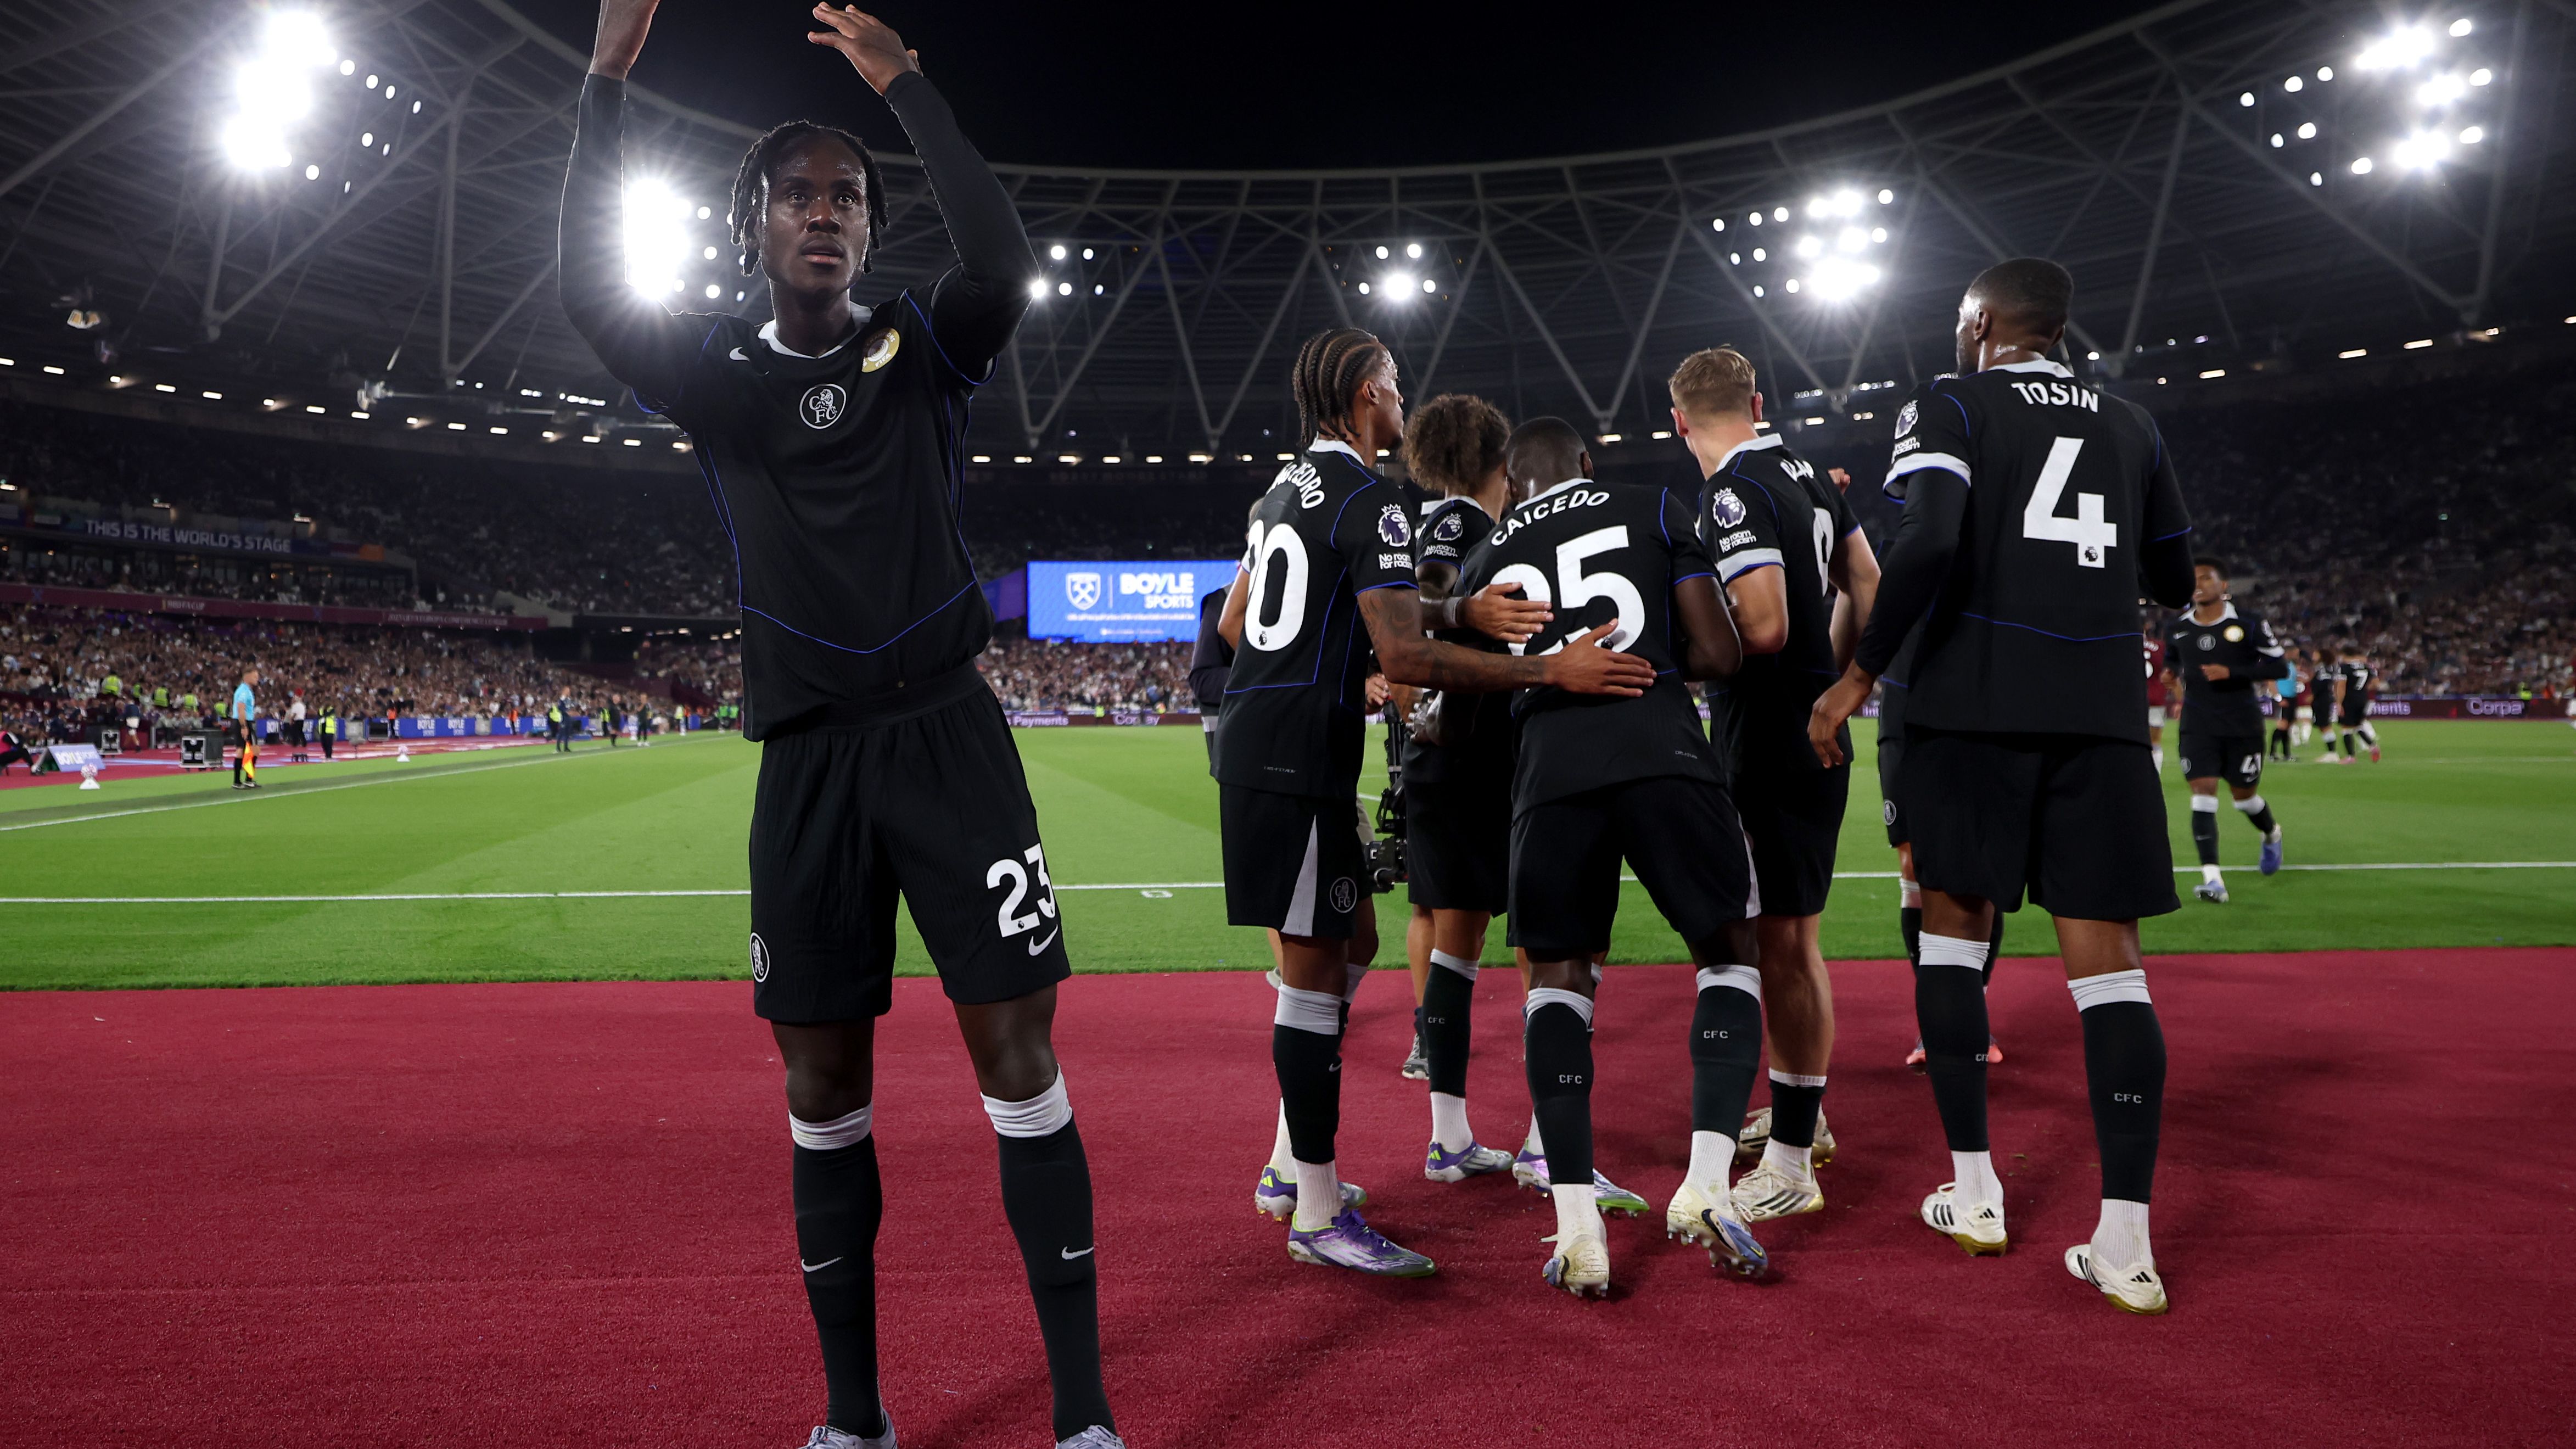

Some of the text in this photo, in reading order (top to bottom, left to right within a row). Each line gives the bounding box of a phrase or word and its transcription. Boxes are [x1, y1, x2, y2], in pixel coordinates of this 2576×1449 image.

[2011, 382, 2099, 413] TOSIN
[2023, 437, 2117, 568] 4
[1491, 489, 1610, 546] CAICEDO
[85, 519, 292, 553] THIS IS THE WORLD'S STAGE
[1719, 529, 1751, 546] No room
[1721, 535, 1757, 553] for racism
[1435, 545, 1456, 553] room
[1379, 553, 1412, 563] No room
[1380, 561, 1393, 570] for
[1120, 573, 1194, 594] BOYLE
[1144, 594, 1194, 609] SPORTS
[2353, 669, 2368, 691] 7
[2466, 697, 2524, 717] Corpa
[417, 719, 435, 729] BOYLE
[448, 719, 465, 729] BOYLE
[1015, 715, 1069, 728] Payments
[987, 843, 1056, 938] 23
[1703, 1030, 1728, 1039] CFC
[1559, 1074, 1582, 1084] CFC
[2114, 1093, 2142, 1104] CFC
